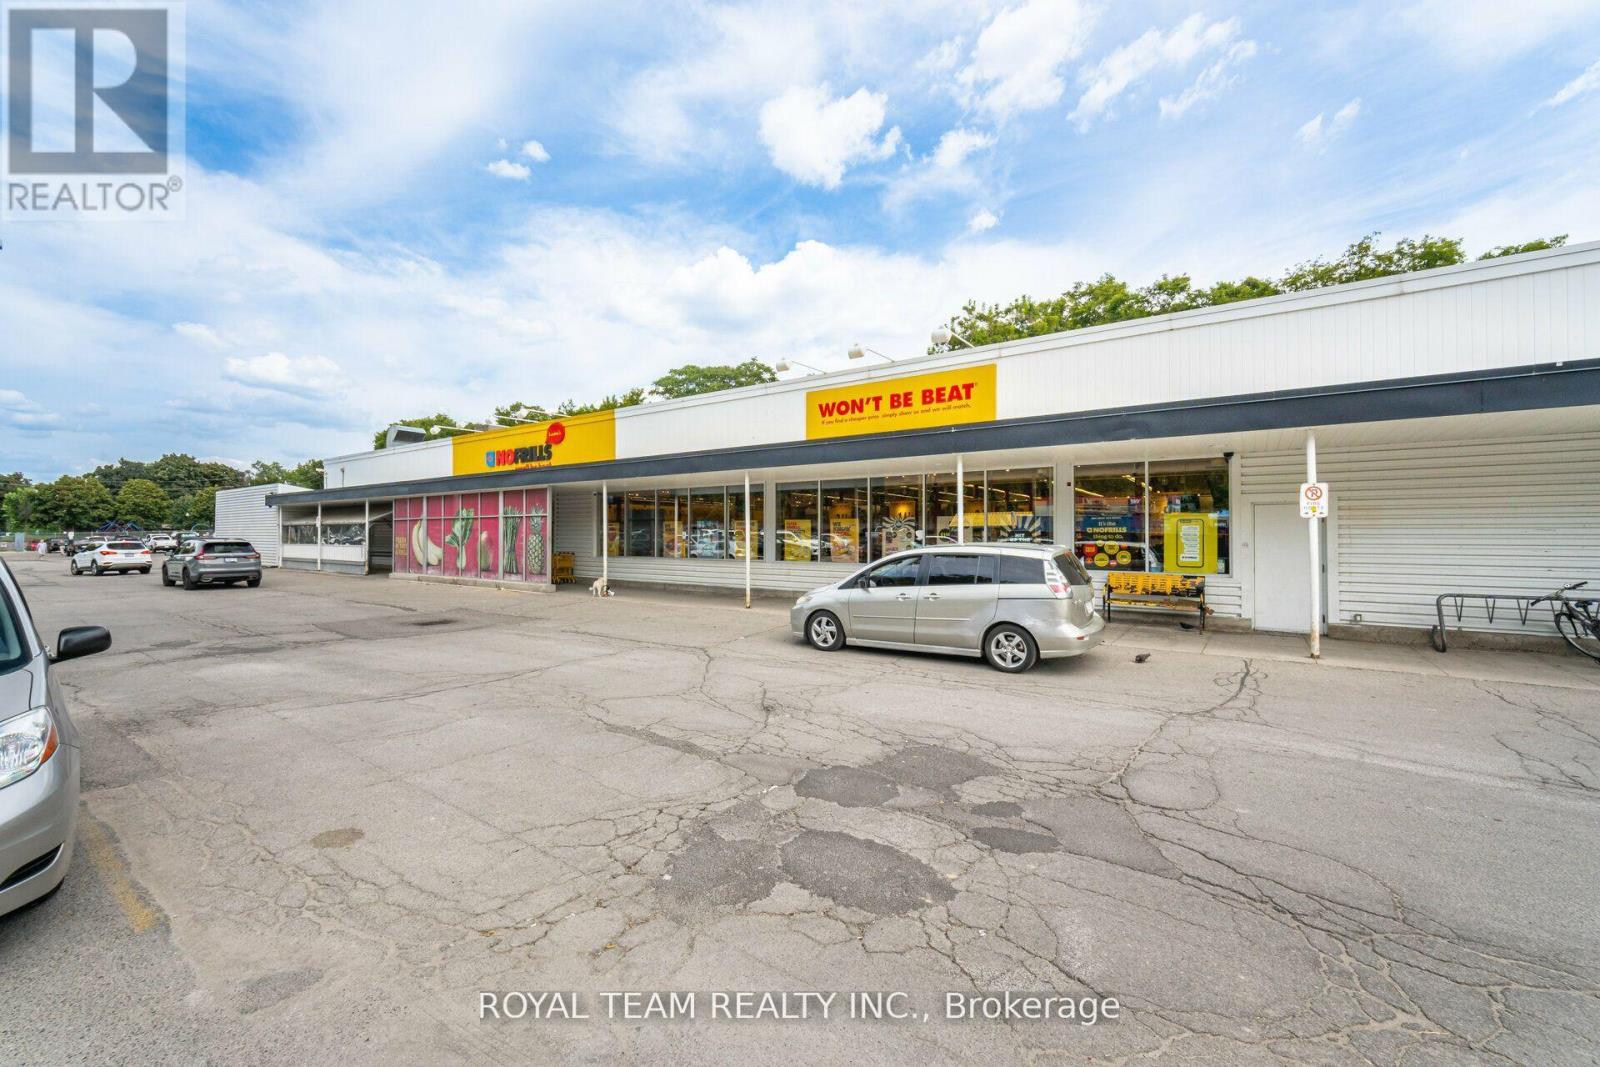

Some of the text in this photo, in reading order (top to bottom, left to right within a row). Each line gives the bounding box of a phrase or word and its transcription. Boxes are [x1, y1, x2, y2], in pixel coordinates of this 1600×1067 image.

[818, 383, 974, 418] WON'T BE BEAT
